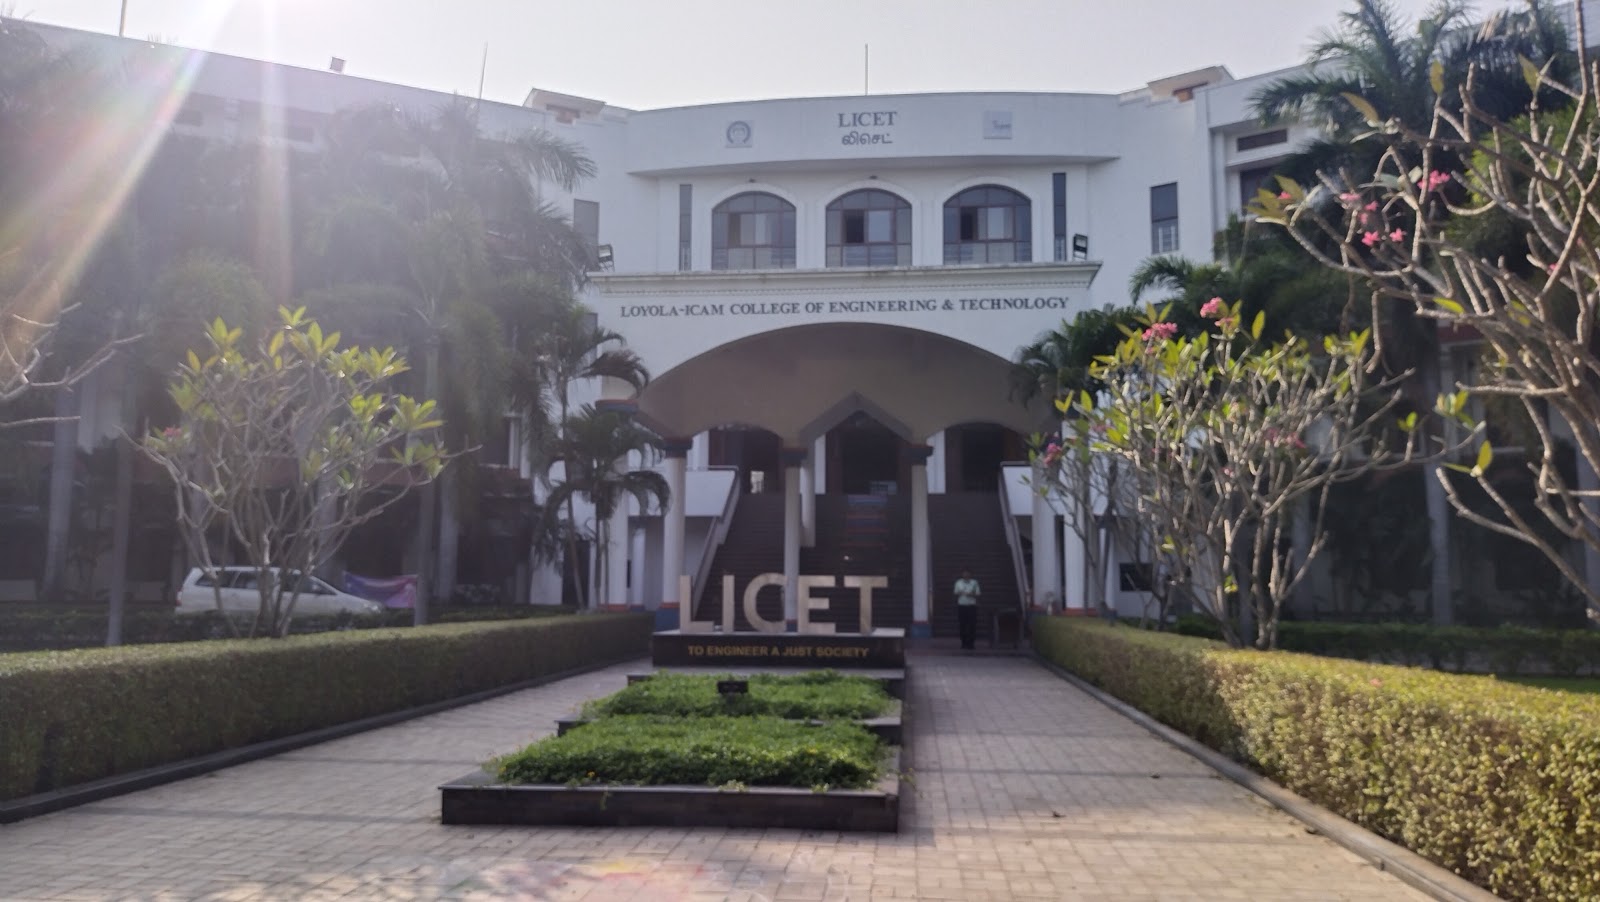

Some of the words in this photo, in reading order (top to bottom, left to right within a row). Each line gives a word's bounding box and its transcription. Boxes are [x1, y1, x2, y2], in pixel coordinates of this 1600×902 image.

[838, 111, 897, 128] LICET
[620, 304, 724, 317] LOYOLA-ICAM
[730, 302, 800, 315] COLLEGE
[805, 302, 825, 313] OF
[829, 300, 937, 313] ENGINEERING
[941, 299, 954, 311] &
[960, 297, 1069, 311] TECHNOLOGY
[679, 572, 888, 635] LICET
[688, 645, 704, 656] TO
[707, 645, 768, 657] ENGINEER
[770, 646, 780, 656] A
[782, 646, 812, 657] JUST
[816, 647, 870, 658] SOCIETY
